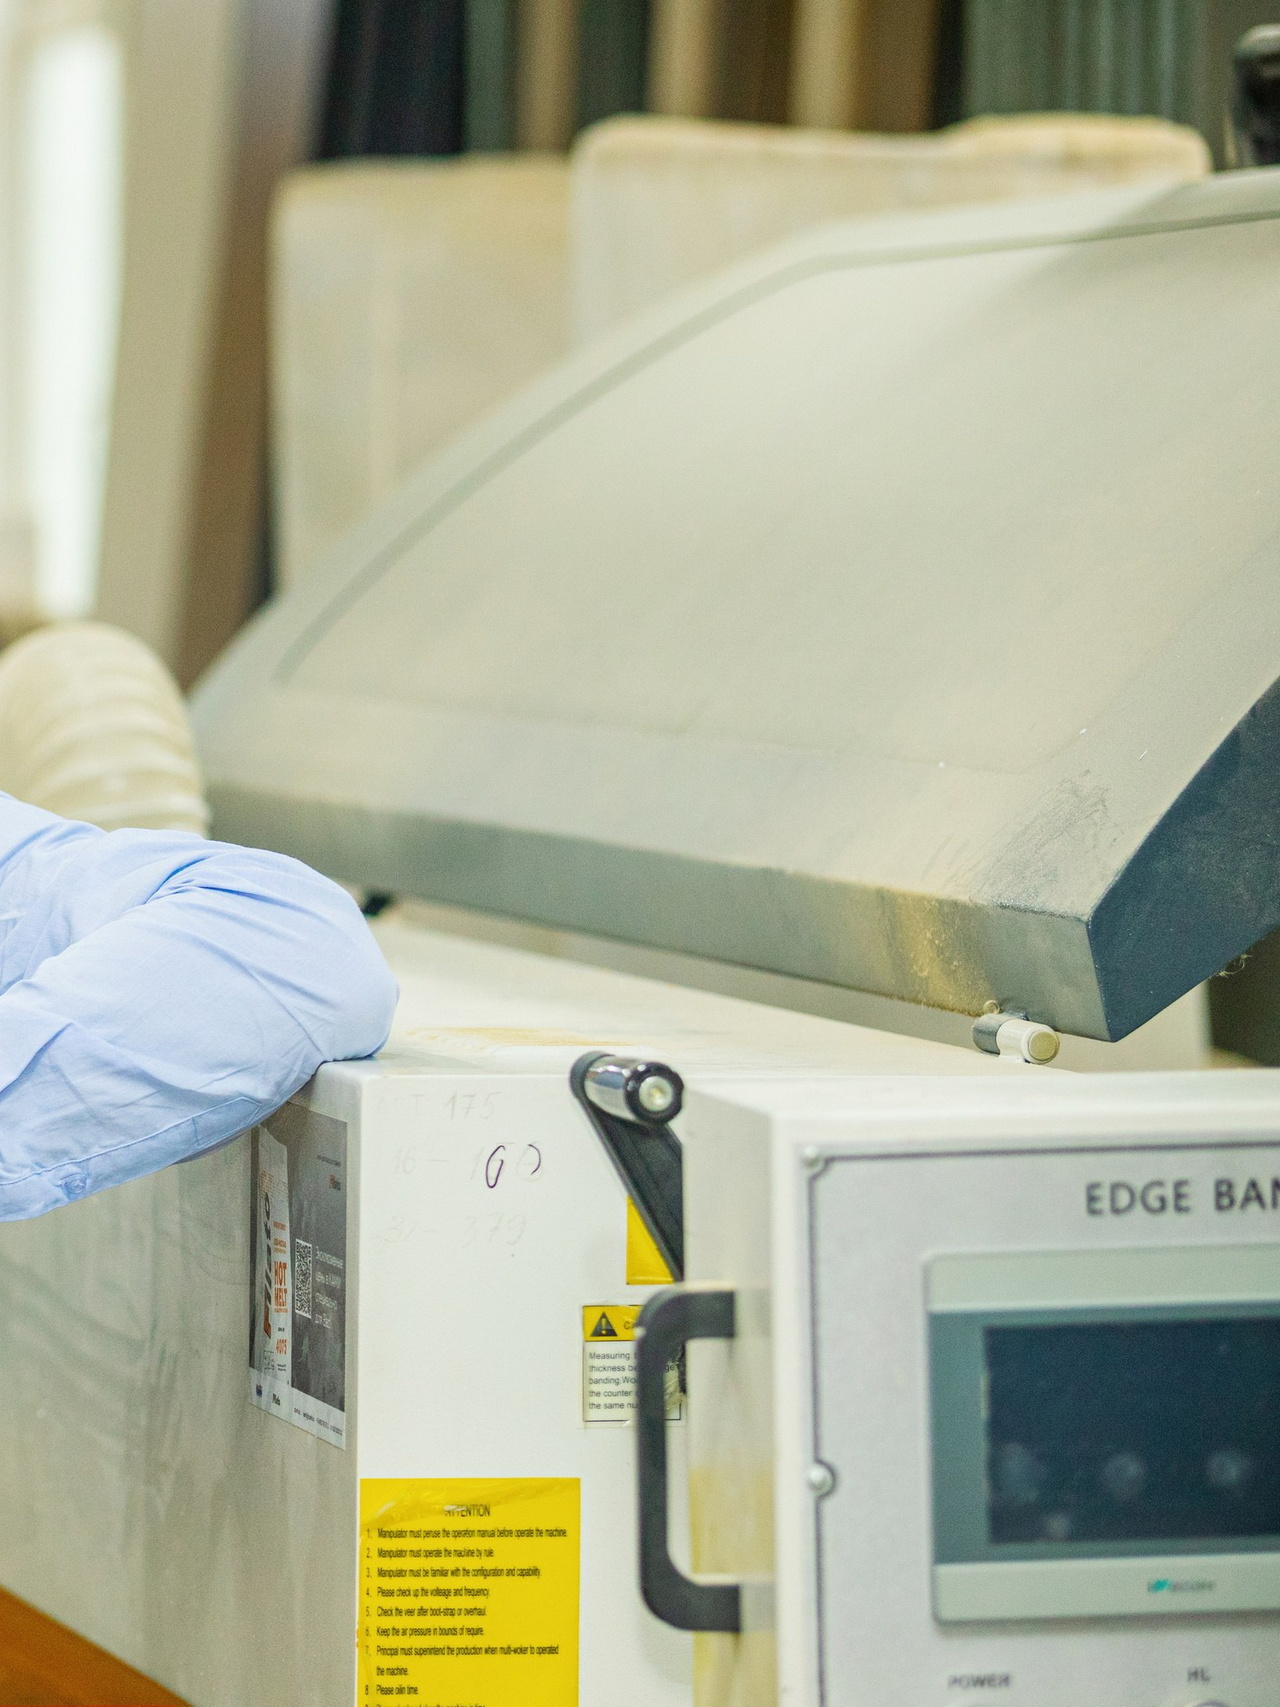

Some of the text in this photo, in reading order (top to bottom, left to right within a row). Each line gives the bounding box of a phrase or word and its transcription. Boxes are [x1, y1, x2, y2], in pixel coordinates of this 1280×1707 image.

[1086, 1179, 1191, 1215] EDGE
[274, 1261, 287, 1286] HOT
[274, 1287, 288, 1307] MELT
[589, 1352, 630, 1360] Measuring
[377, 1527, 408, 1540] Manipulator
[409, 1527, 422, 1538] must
[442, 1527, 450, 1538] the
[451, 1527, 475, 1540] operation
[477, 1527, 496, 1538] manual
[497, 1527, 513, 1538] before
[515, 1527, 534, 1540] operate
[535, 1527, 543, 1538] the
[377, 1548, 407, 1560] Manipulator
[409, 1547, 422, 1558] must
[423, 1547, 442, 1559] operate
[444, 1547, 452, 1558] the
[453, 1547, 475, 1558] machine
[476, 1547, 482, 1559] by
[377, 1566, 407, 1579] Manipulator
[408, 1566, 421, 1577] must
[423, 1566, 429, 1577] be
[450, 1566, 461, 1577] with
[462, 1566, 470, 1577] the
[505, 1566, 515, 1577] and
[377, 1586, 395, 1597] Please
[396, 1586, 411, 1597] check
[412, 1589, 420, 1599] up
[420, 1586, 429, 1597] the
[453, 1586, 463, 1597] and
[377, 1606, 393, 1616] Check
[394, 1606, 403, 1616] the
[417, 1606, 428, 1616] after
[376, 1626, 390, 1638] Keep
[392, 1626, 400, 1636] the
[409, 1628, 432, 1638] pressure
[432, 1625, 437, 1636] in
[439, 1625, 458, 1636] bounds
[459, 1625, 464, 1636] of
[377, 1645, 399, 1658] Principal
[400, 1645, 413, 1655] must
[447, 1645, 455, 1655] the
[456, 1645, 483, 1657] production
[484, 1645, 498, 1655] when
[530, 1645, 535, 1655] to
[536, 1645, 559, 1657] operated
[376, 1665, 385, 1676] the
[365, 1685, 369, 1696] 8
[376, 1684, 394, 1695] Please
